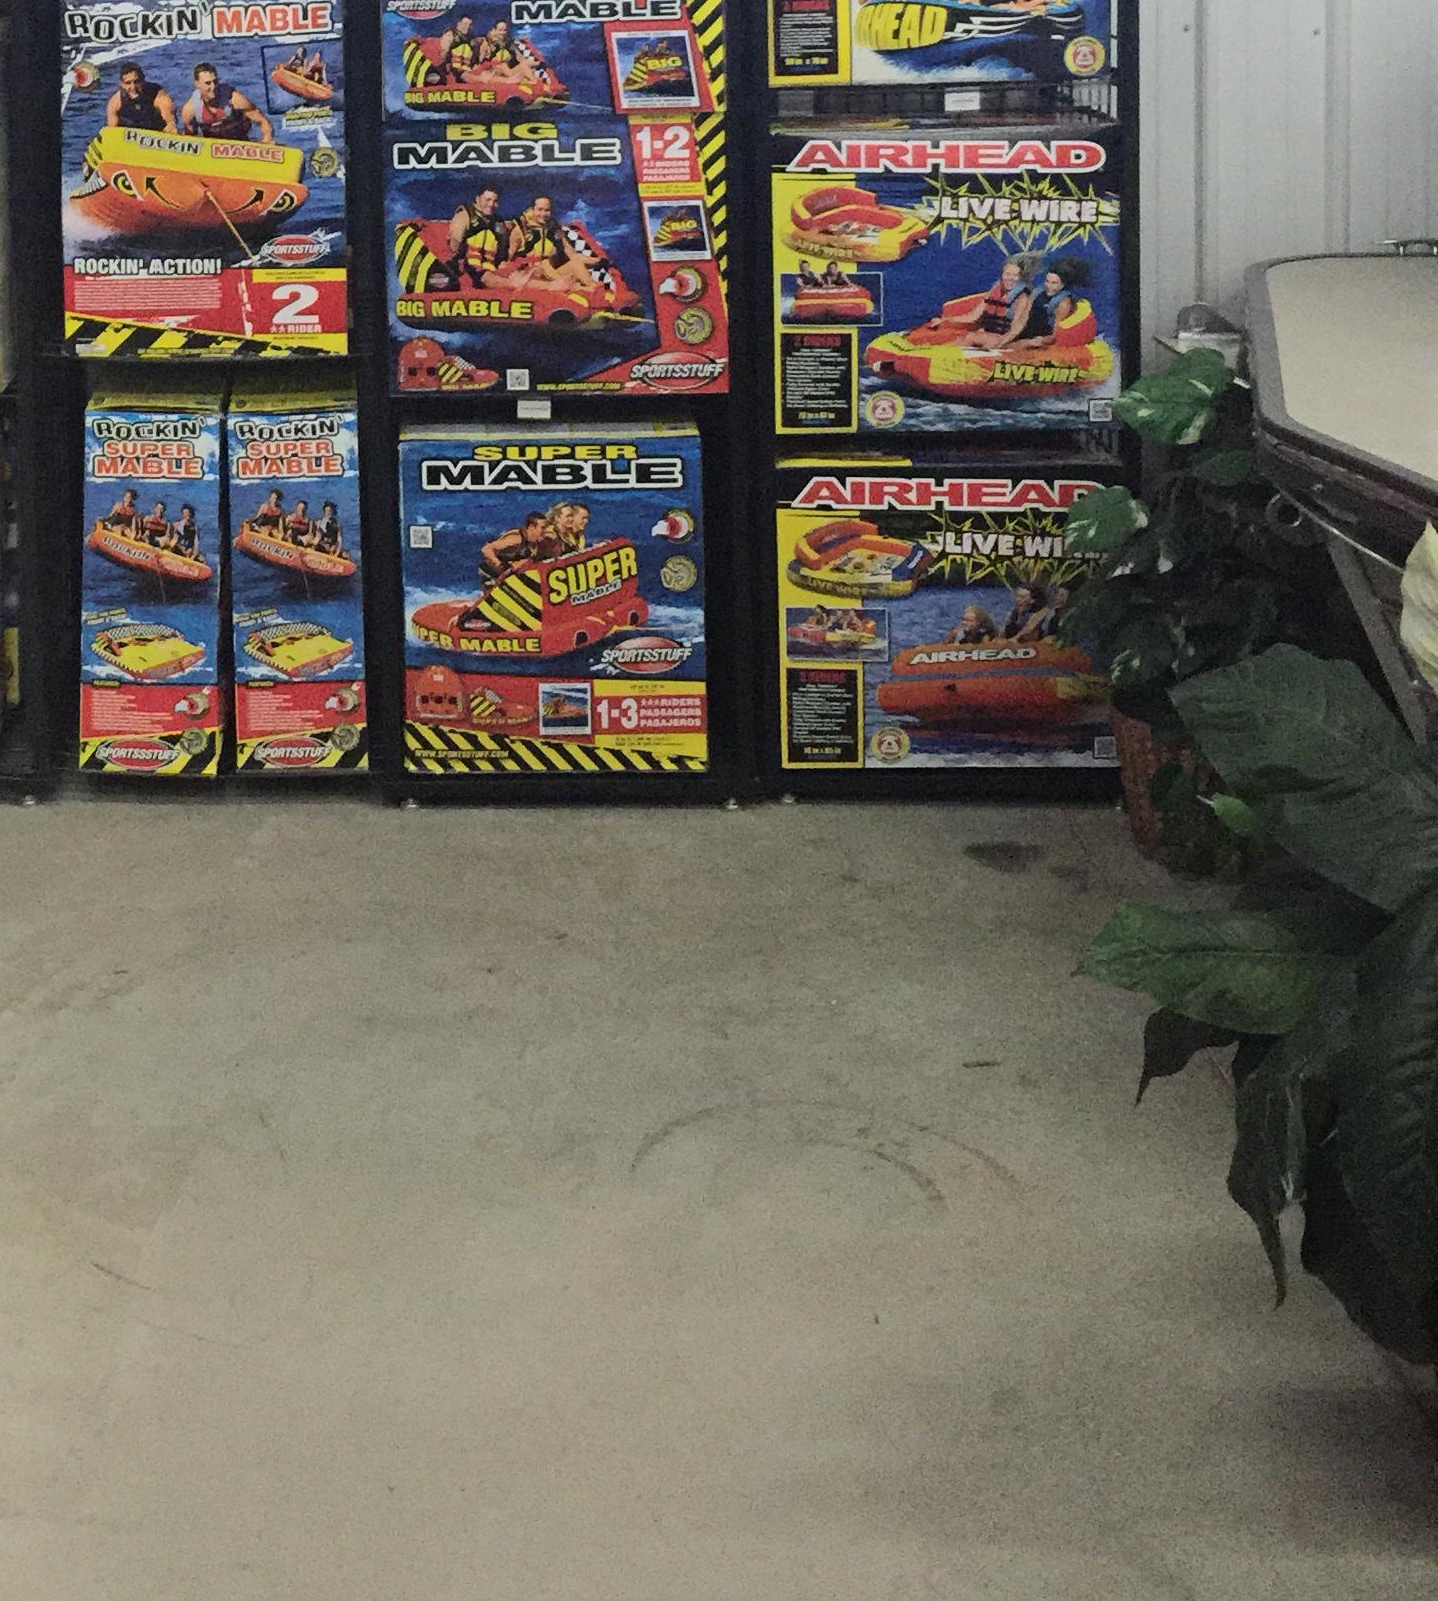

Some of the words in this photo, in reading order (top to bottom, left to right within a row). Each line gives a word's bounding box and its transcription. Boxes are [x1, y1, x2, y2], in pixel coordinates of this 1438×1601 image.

[211, 2, 334, 38] MABLE
[427, 89, 496, 104] MABLE
[445, 121, 559, 141] BIG
[634, 125, 692, 160] 1-2
[392, 138, 623, 170] MABLE
[785, 140, 1107, 174] AIRHEAD
[271, 283, 319, 324] 2
[396, 300, 427, 318] BIG
[431, 299, 534, 319] MABLE
[630, 362, 725, 379] SPORTSSTUFF
[103, 440, 196, 458] SUPER
[247, 440, 335, 458] SUPER
[473, 444, 638, 461] SUPER
[93, 455, 204, 479] MABLE
[237, 454, 343, 478] MABLE
[422, 458, 684, 491] MABLE
[547, 545, 639, 606] SUPER
[600, 647, 692, 664] SPORTSSTUFF
[910, 648, 1038, 667] AIRHEAD
[597, 698, 638, 729] 1-3
